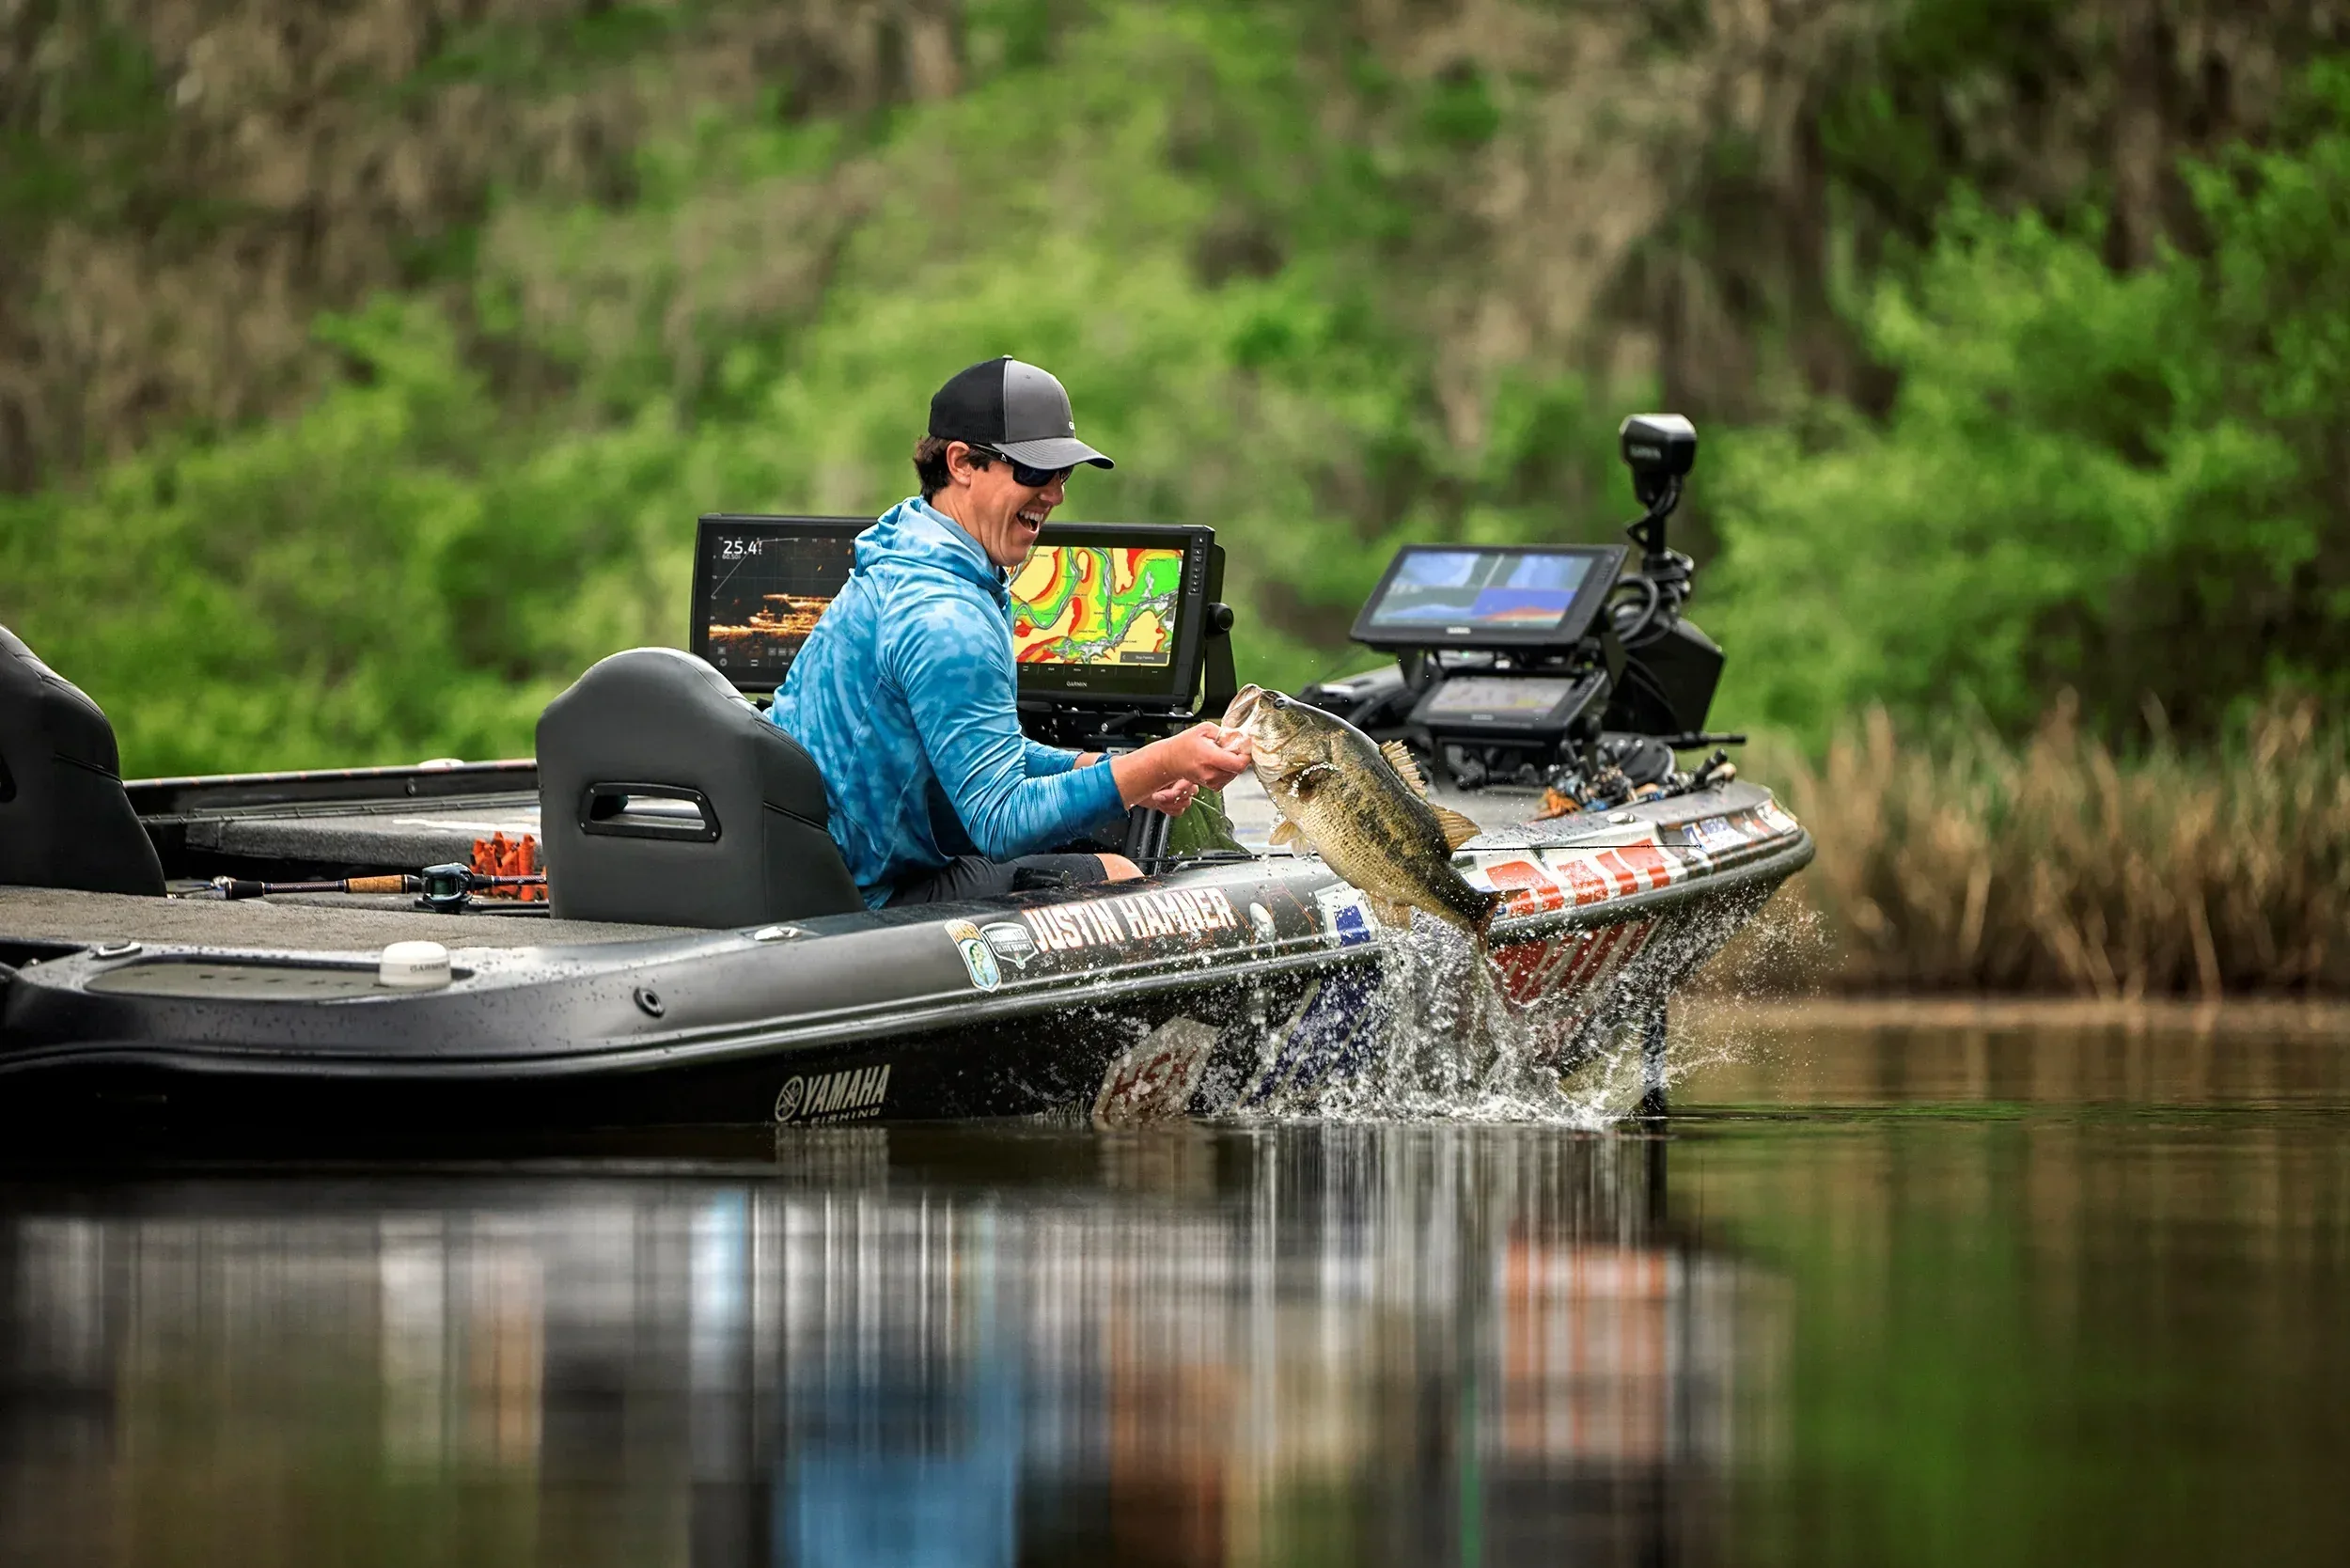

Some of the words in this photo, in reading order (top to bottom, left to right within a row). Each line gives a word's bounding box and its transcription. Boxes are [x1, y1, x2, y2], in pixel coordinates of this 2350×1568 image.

[723, 540, 758, 556] 25.4
[1066, 680, 1088, 688] GARMIN
[1022, 901, 1126, 953] JUSTIN
[1114, 886, 1238, 940] HAMNER
[410, 962, 447, 973] GARMIN
[801, 1063, 891, 1116] YAMAHA
[810, 1106, 881, 1125] FISHING
